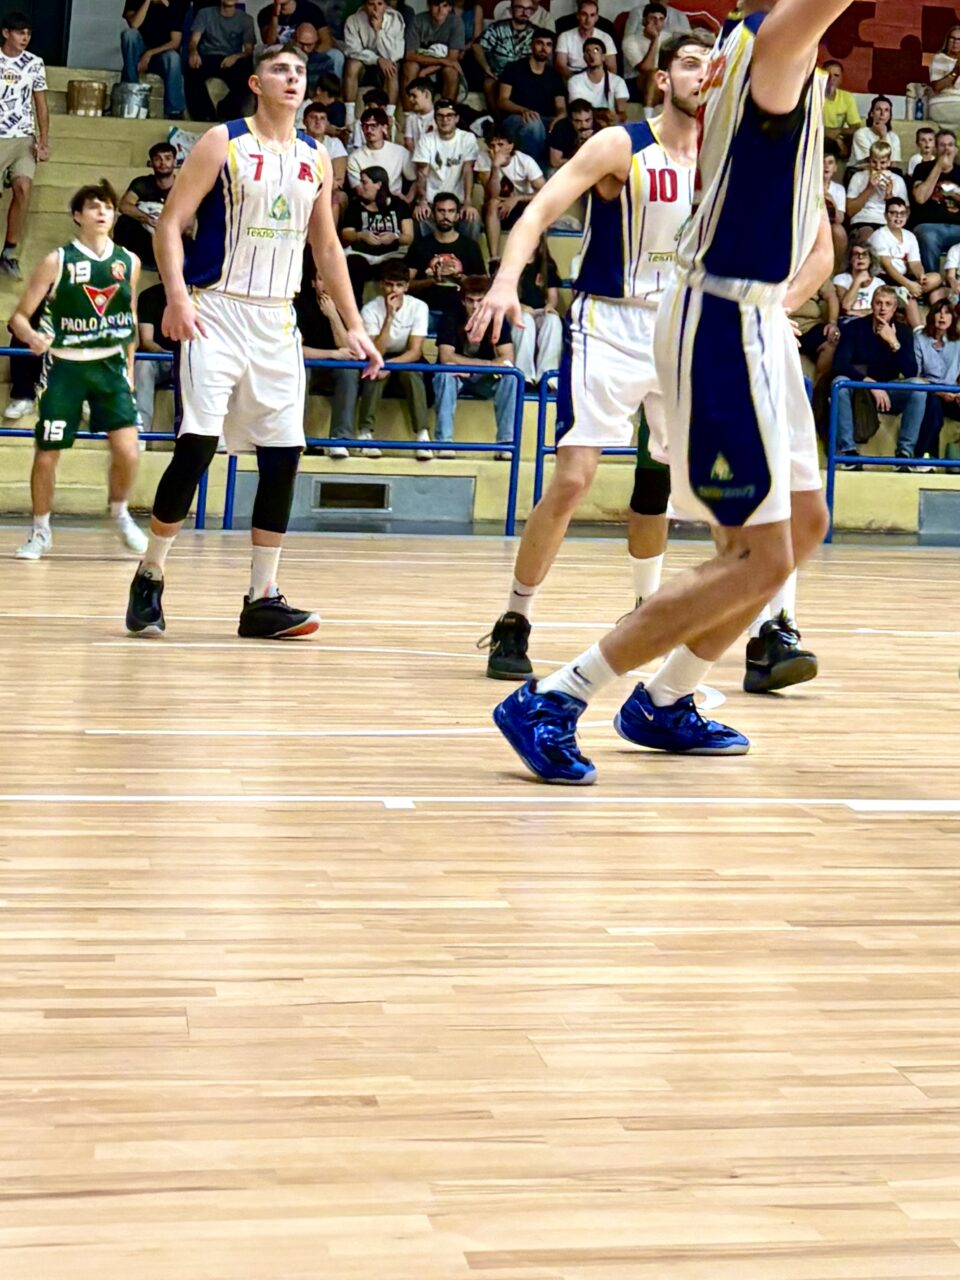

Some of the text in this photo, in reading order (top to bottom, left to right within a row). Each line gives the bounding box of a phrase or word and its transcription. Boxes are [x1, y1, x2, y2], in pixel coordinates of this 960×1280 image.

[248, 153, 264, 181] 7
[646, 168, 678, 203] 10
[61, 317, 98, 333] PAOLO
